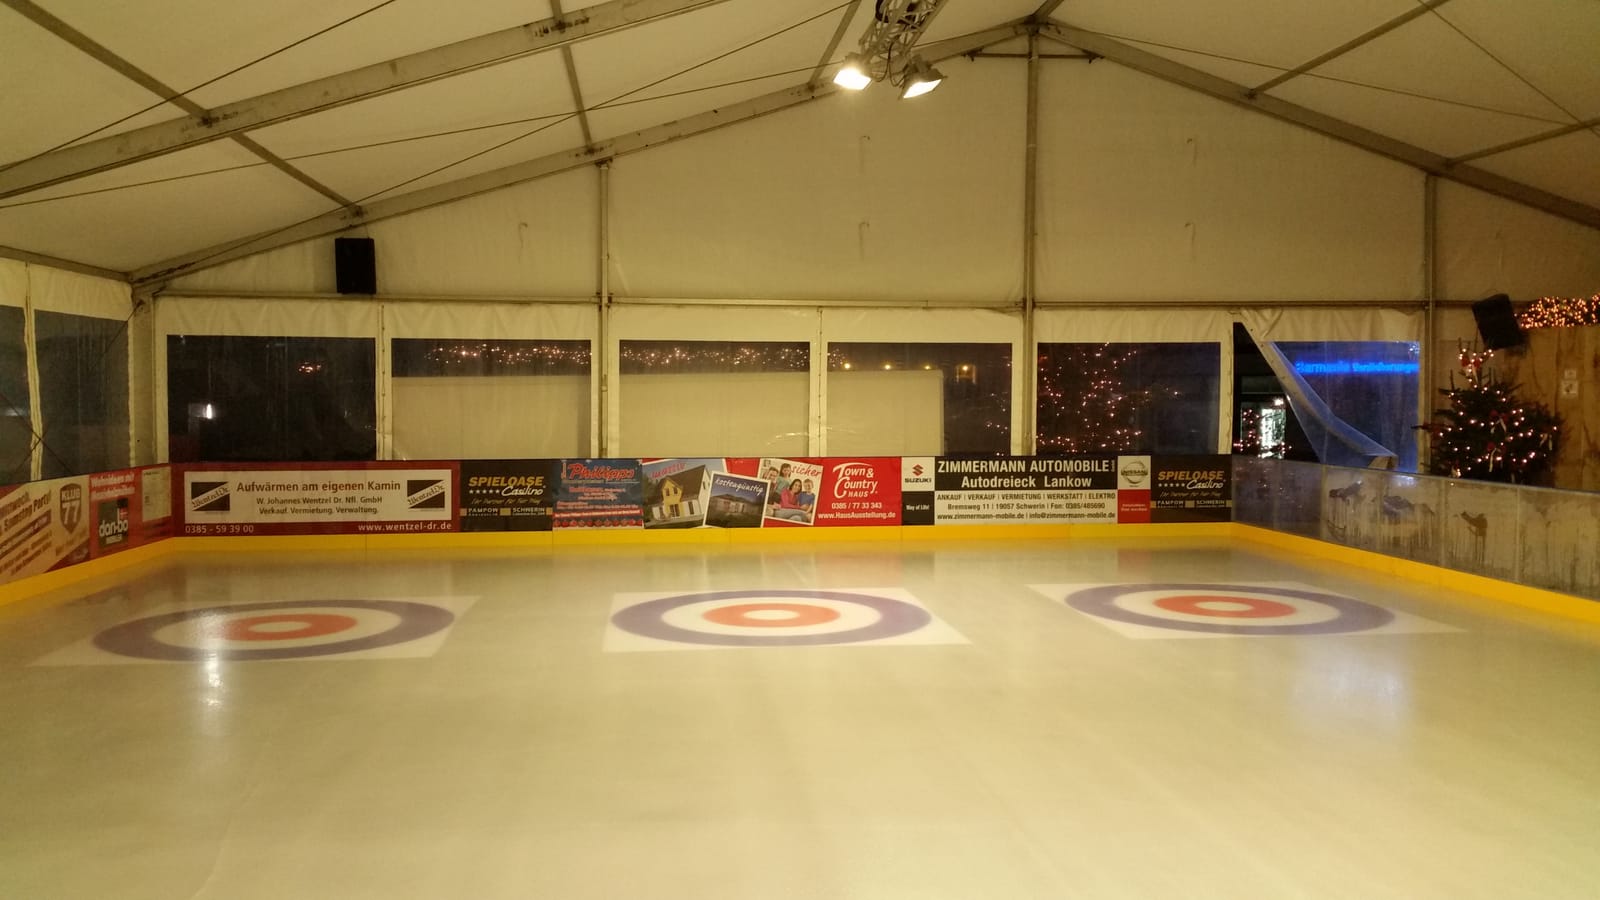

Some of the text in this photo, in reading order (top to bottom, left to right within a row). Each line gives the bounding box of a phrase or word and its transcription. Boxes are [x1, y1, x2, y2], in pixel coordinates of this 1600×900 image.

[790, 463, 821, 478] sicher
[833, 462, 875, 480] Town &
[937, 459, 1110, 474] ZIMMERMANN AUTOMOBILE
[468, 476, 545, 487] SPIELOASE
[1157, 471, 1225, 481] SPIELOASE
[237, 479, 401, 494] Aufwärmen am eigenen Kamin
[714, 477, 765, 497] kostengünstig
[834, 476, 879, 499] Country
[961, 475, 1092, 489] Autodreieck Lankow
[501, 485, 544, 497] Casilino
[848, 490, 869, 498] HAUS
[1088, 492, 1116, 500] ELEKTRO
[266, 496, 301, 506] Johannes
[302, 496, 332, 505] Wentzel
[360, 495, 383, 504] GmbH
[831, 502, 848, 510] 0385
[852, 502, 861, 510] 77
[861, 502, 870, 510] 33
[870, 502, 884, 510] 343
[62, 501, 81, 525] 77
[947, 503, 981, 512] Bremsweg
[937, 512, 1024, 520] www.zimmermann-mobile.de
[184, 525, 207, 534] 0385
[215, 524, 228, 533] 59
[229, 524, 241, 533] 39
[242, 524, 255, 533] 00
[358, 520, 452, 531] www.wentzel-dr.de
